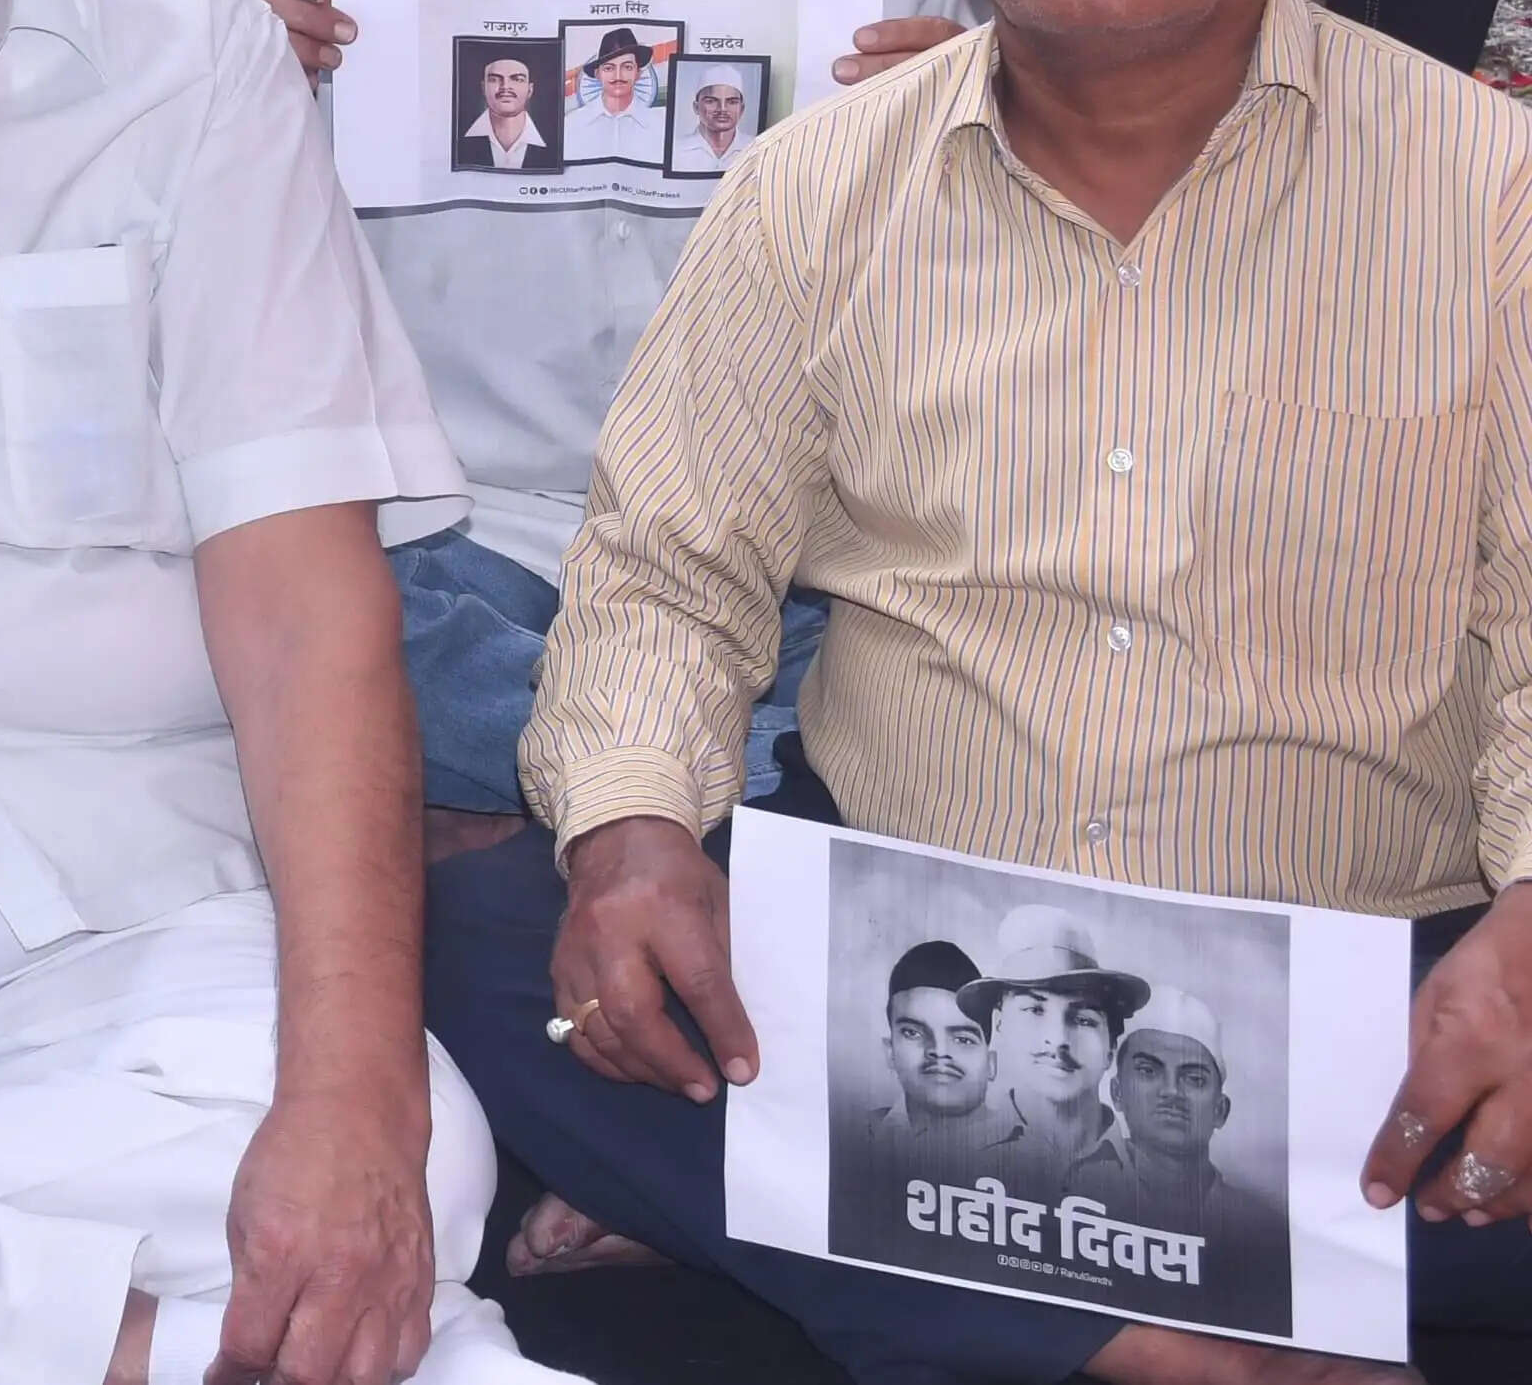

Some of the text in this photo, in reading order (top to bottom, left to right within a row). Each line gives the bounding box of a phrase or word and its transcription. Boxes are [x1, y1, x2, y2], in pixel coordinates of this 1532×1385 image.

[589, 0, 650, 15] भगत सिंह
[483, 21, 528, 37] राजगुरु
[700, 36, 744, 51] सुखदेव
[906, 1177, 1206, 1285] शहीद दिवस
